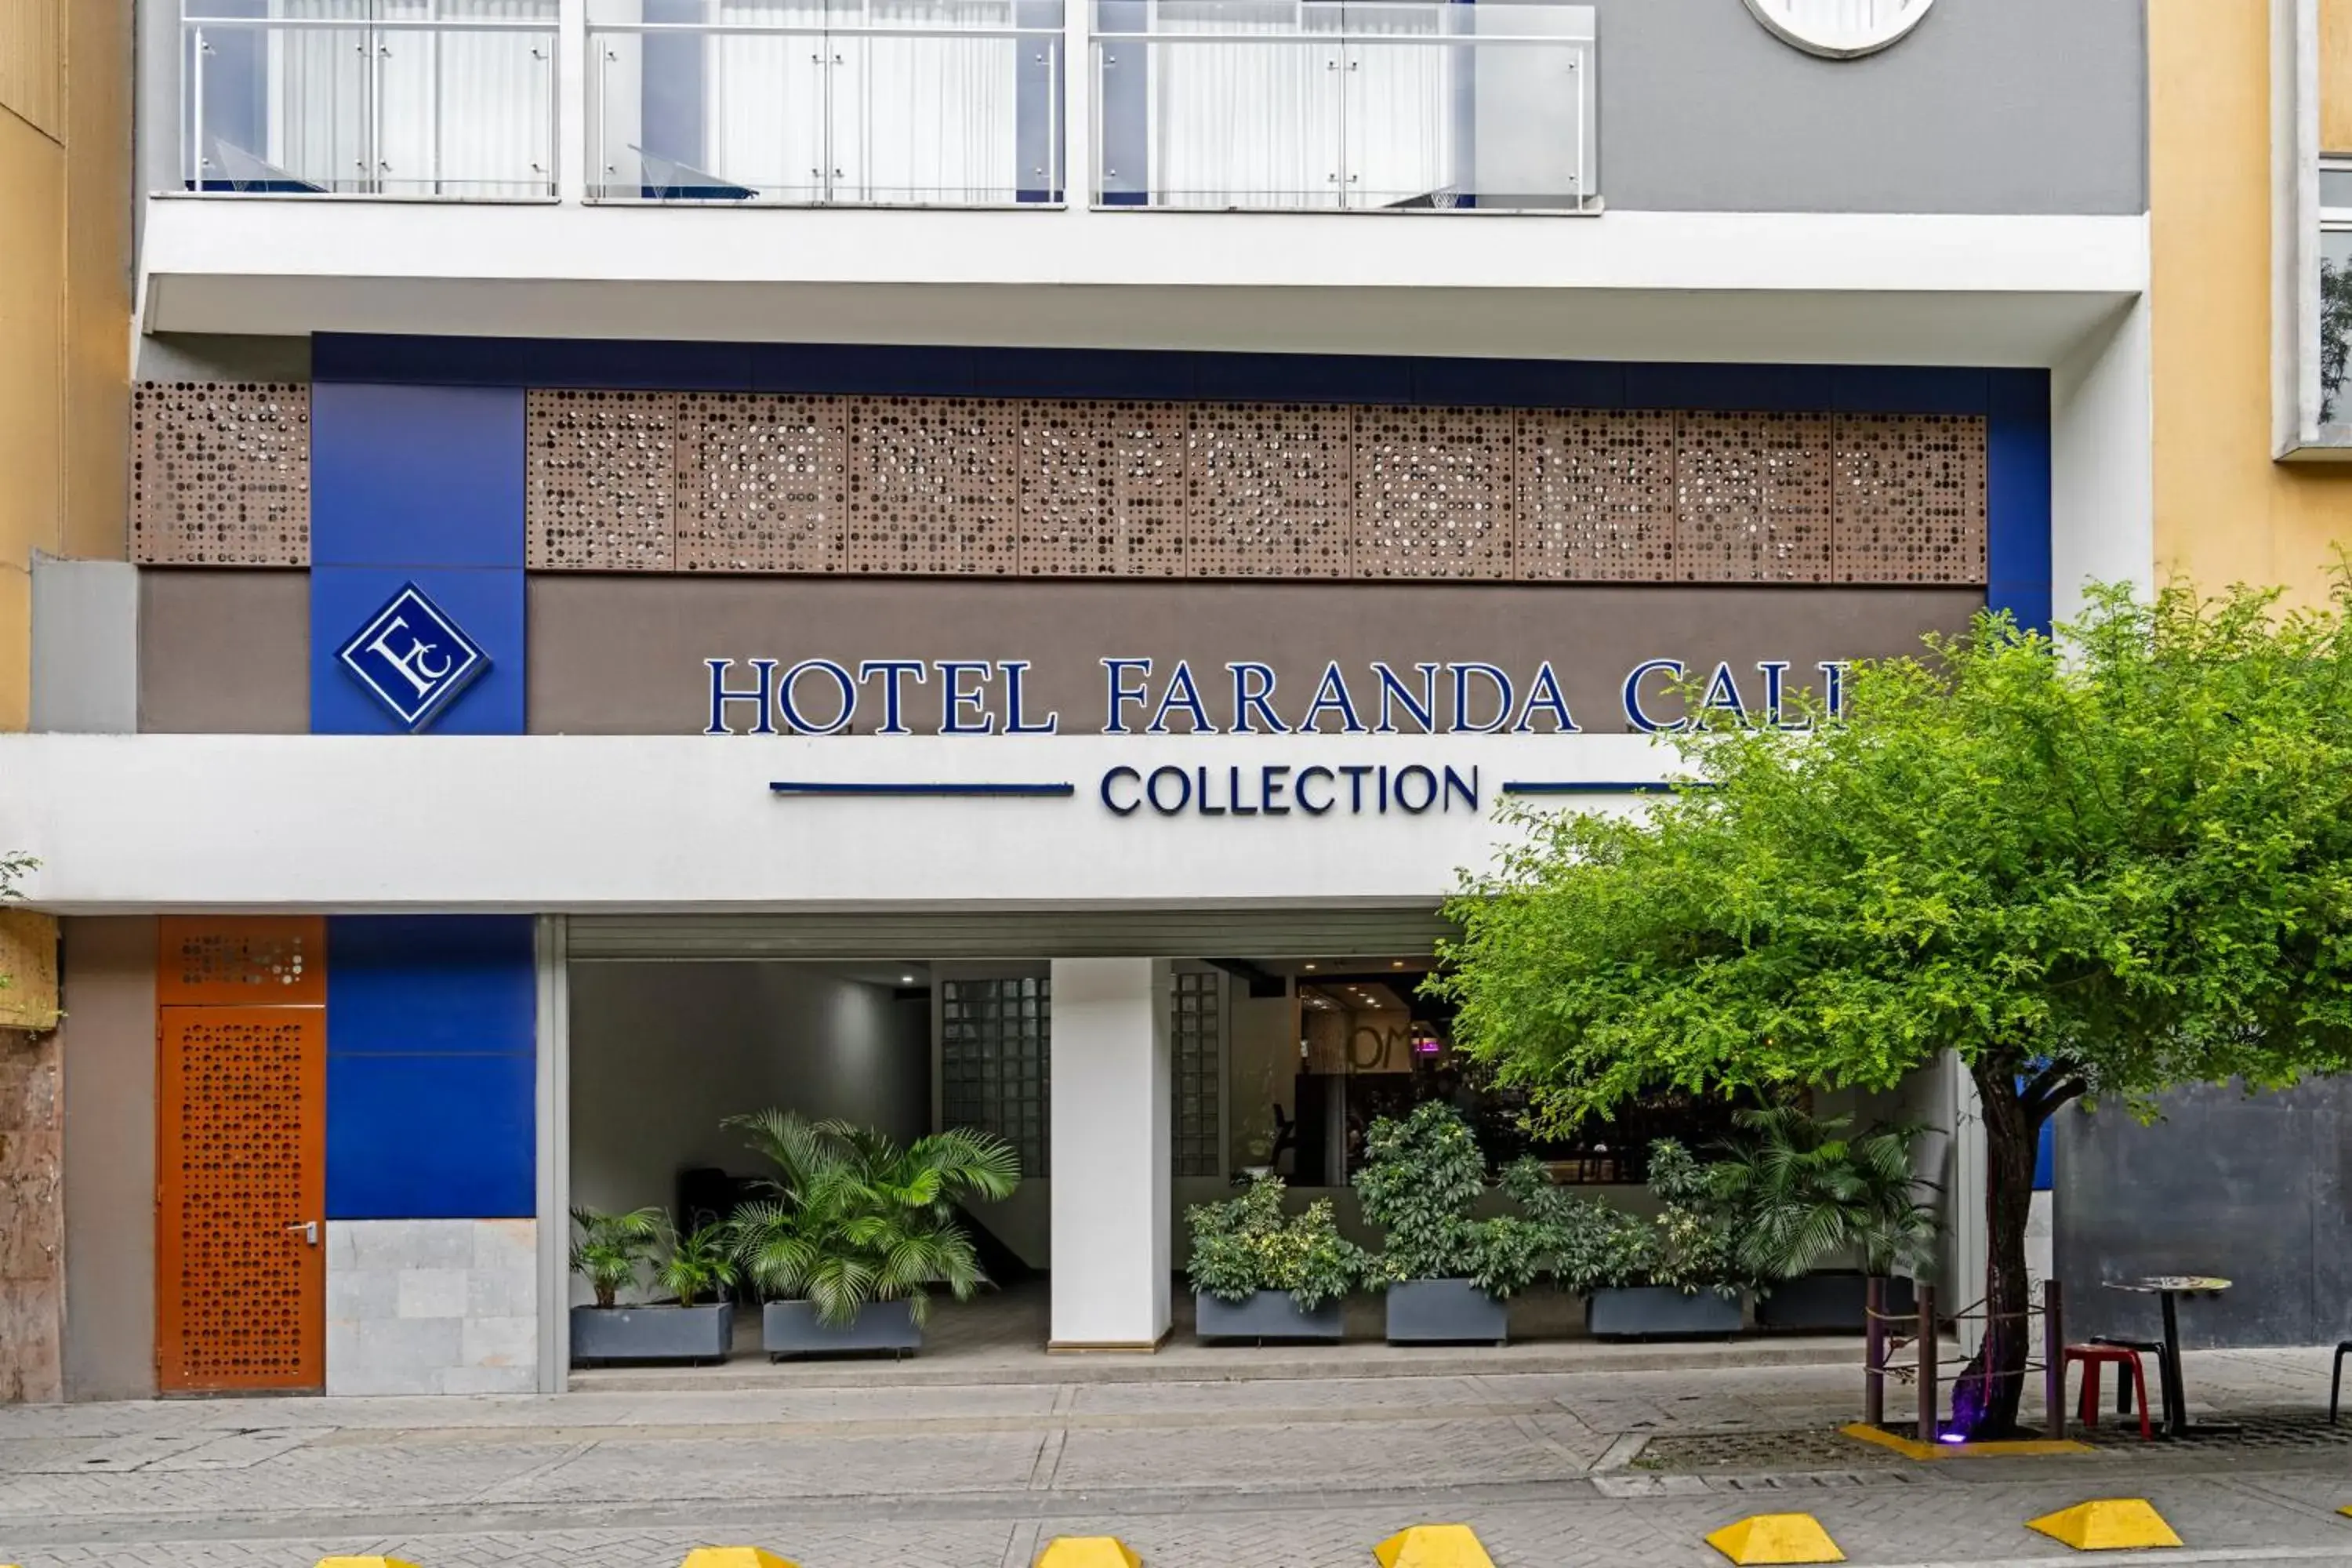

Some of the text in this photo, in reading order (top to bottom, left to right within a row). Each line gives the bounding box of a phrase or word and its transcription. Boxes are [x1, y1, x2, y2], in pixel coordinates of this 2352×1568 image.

[704, 657, 1850, 735] HOTEL FARANDA CALI
[1100, 763, 1479, 816] COLLECTION
